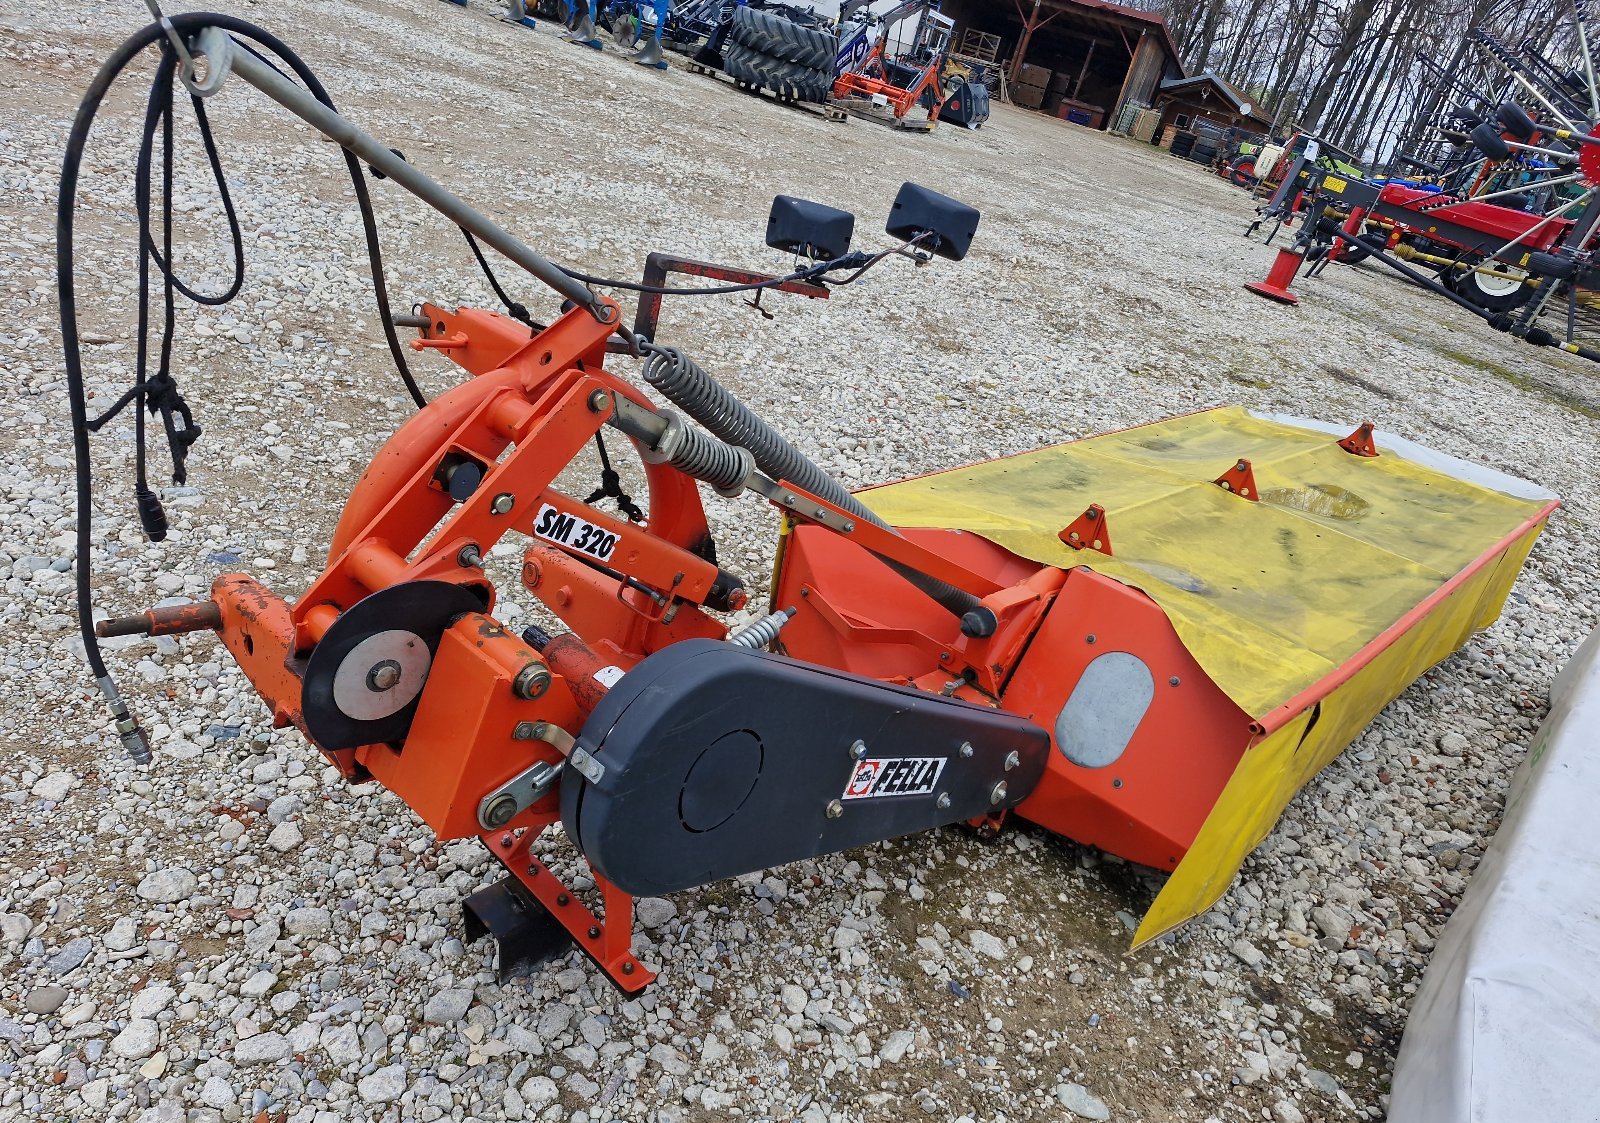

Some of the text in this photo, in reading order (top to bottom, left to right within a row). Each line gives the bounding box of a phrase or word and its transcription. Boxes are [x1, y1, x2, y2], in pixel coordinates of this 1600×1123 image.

[536, 508, 616, 559] SM 320
[870, 760, 940, 793] FELLA
